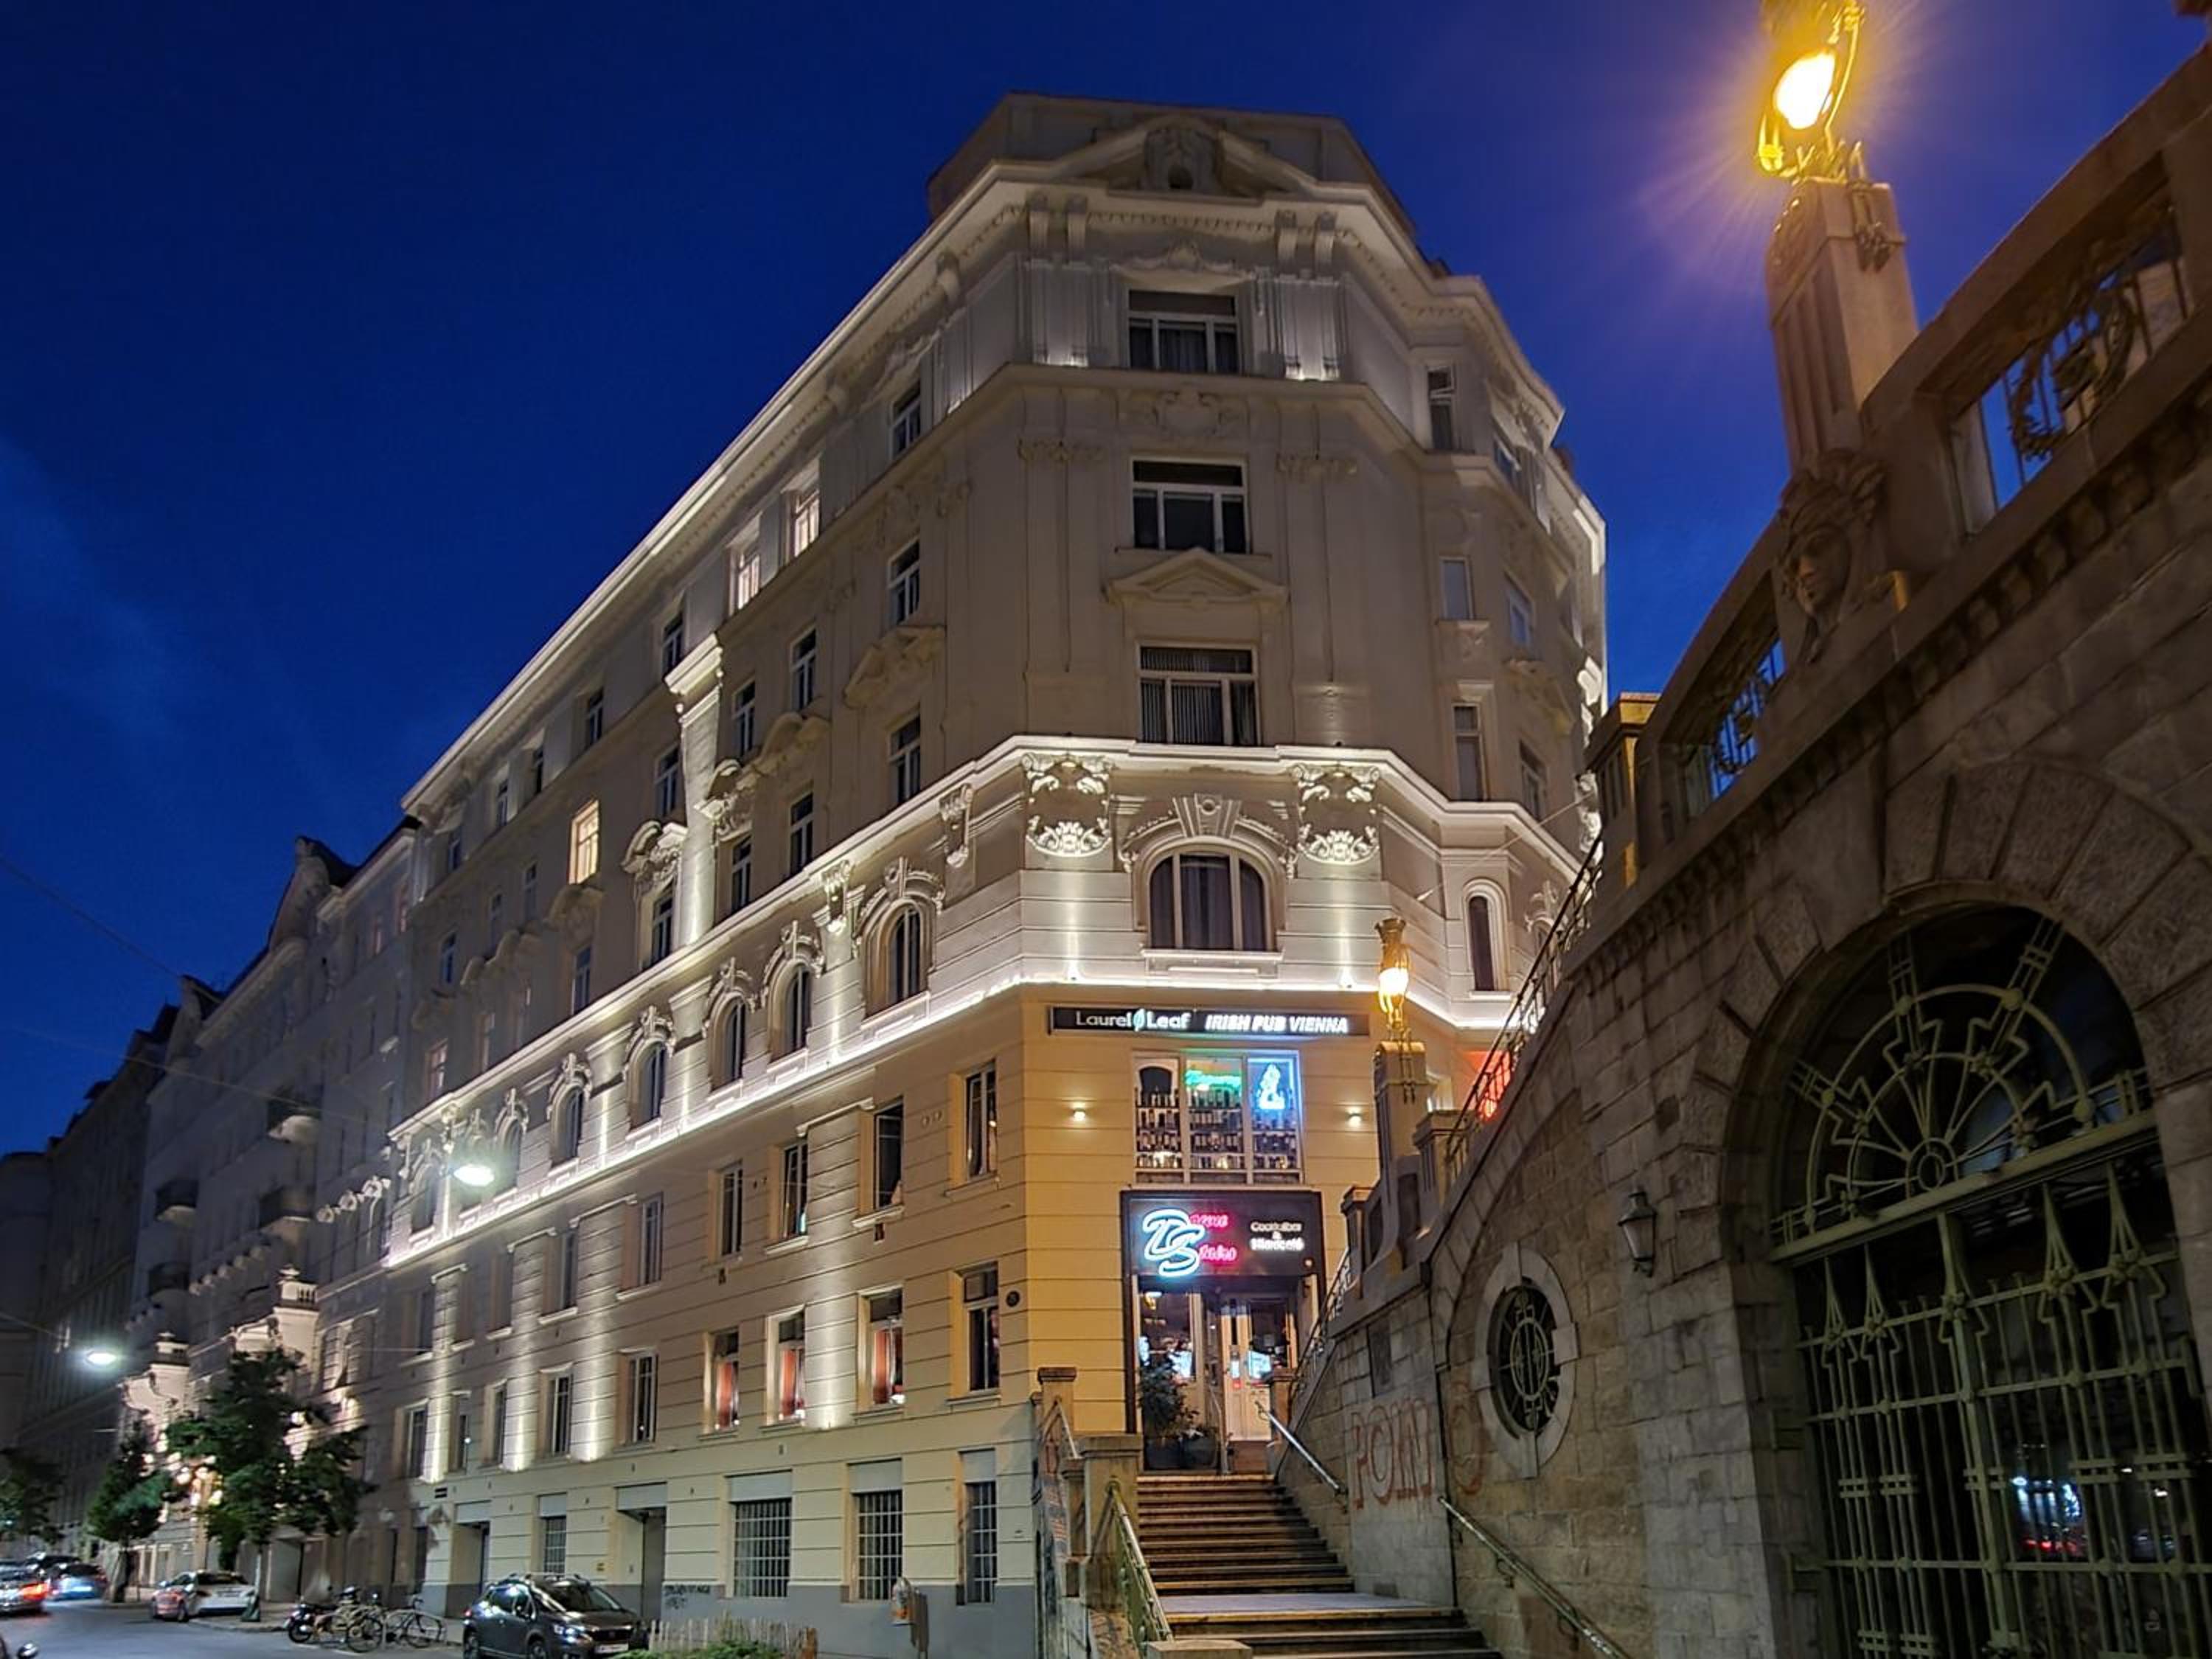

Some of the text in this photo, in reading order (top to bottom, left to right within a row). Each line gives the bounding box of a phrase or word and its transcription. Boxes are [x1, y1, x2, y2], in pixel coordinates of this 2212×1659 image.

[1076, 1010, 1349, 1034] Laurel Leaf IRISH PUB VIENNA
